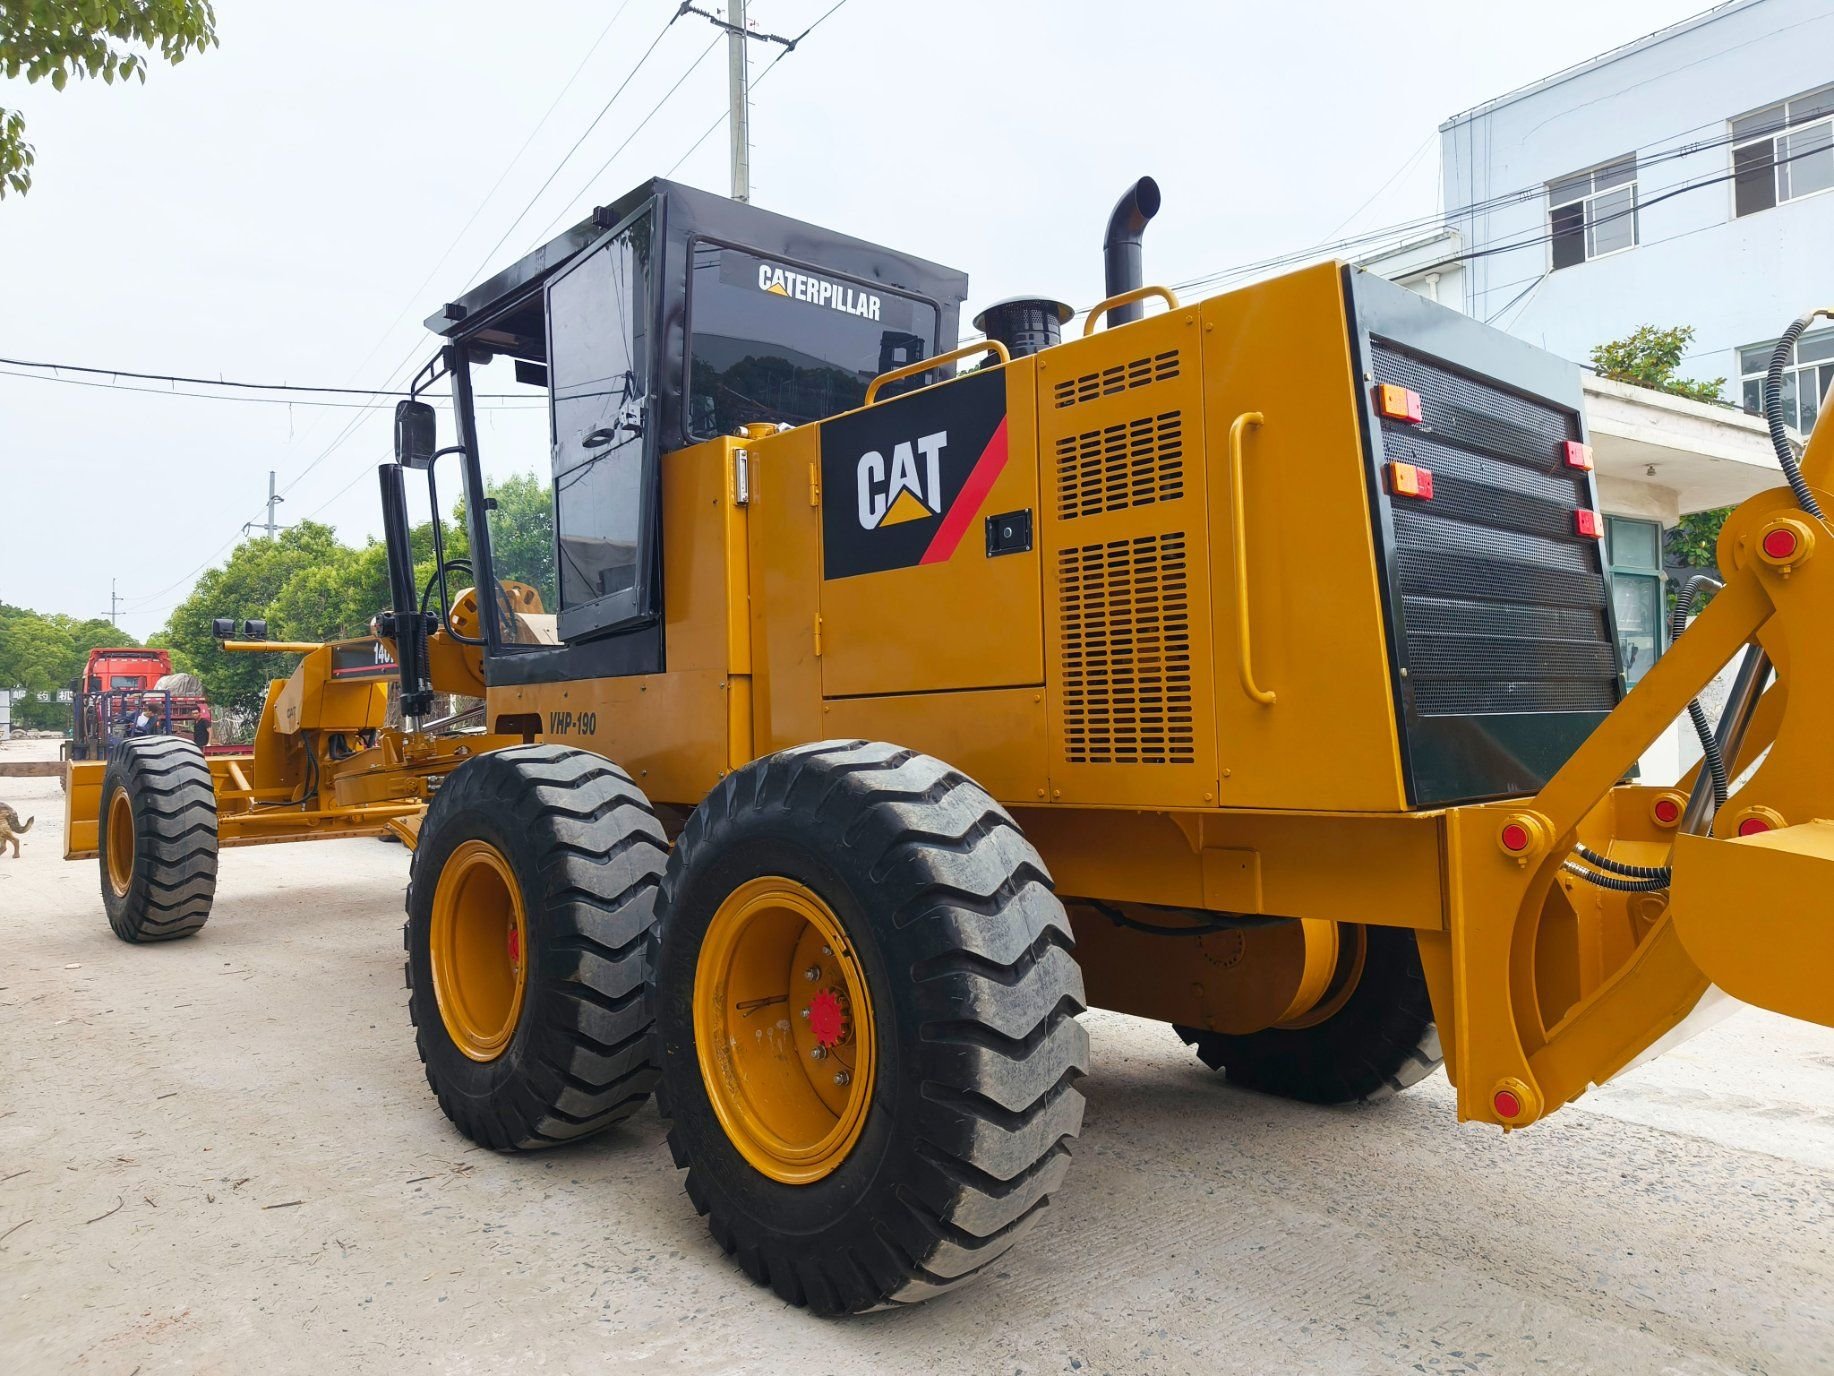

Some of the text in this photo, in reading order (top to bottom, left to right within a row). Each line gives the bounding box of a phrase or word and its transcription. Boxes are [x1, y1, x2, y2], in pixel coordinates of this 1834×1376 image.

[758, 264, 881, 322] CATERPILLAR
[857, 430, 948, 530] CAT
[373, 642, 394, 665] 140
[550, 711, 597, 736] VHP-190
